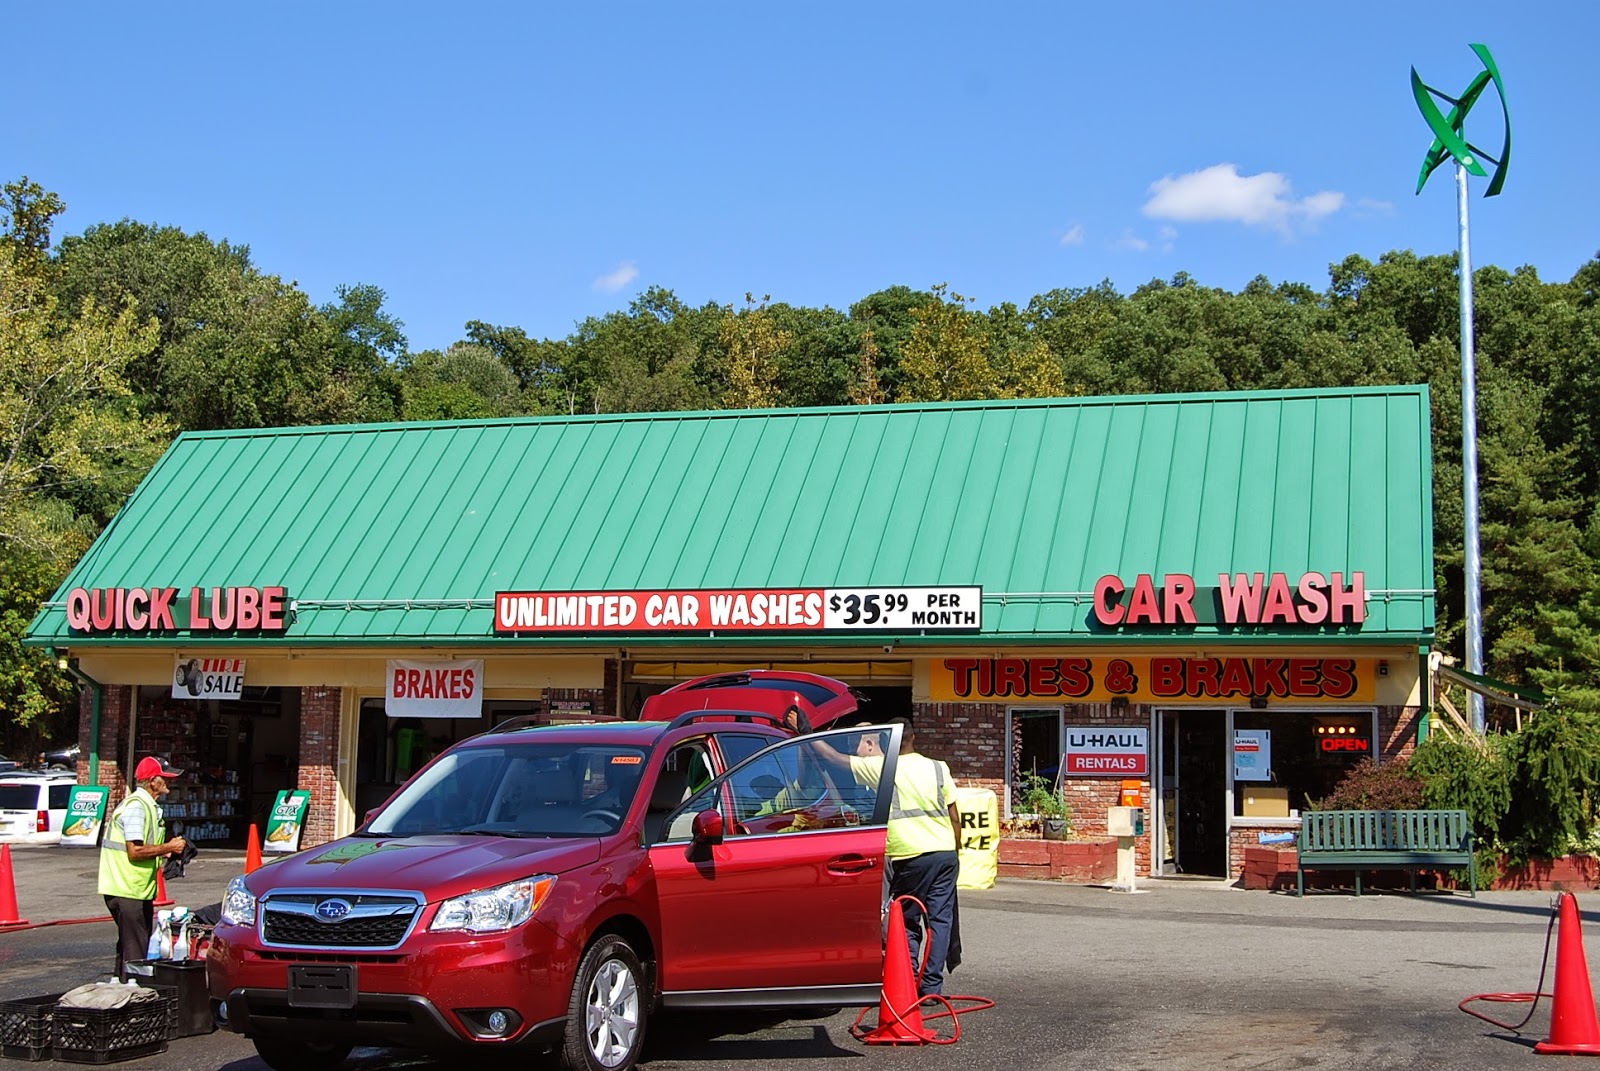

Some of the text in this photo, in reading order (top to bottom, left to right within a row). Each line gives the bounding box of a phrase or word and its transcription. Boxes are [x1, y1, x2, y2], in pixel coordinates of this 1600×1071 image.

[927, 594, 960, 607] PER
[1093, 571, 1365, 625] CAR WASH
[66, 586, 284, 632] QUICK LUBE
[500, 592, 822, 627] UNLIMITED CAR WASHES
[829, 593, 908, 625] $35.99
[912, 611, 976, 625] MONTH
[204, 675, 244, 693] SALE
[393, 669, 475, 699] BRAKES
[944, 657, 1357, 698] TIRES & BRAKES
[1070, 734, 1143, 747] U-HAUL
[1321, 738, 1368, 751] OPEN
[1076, 757, 1137, 769] RENTALS
[73, 801, 99, 811] GTX
[276, 805, 299, 815] GTX
[960, 811, 990, 828] RE
